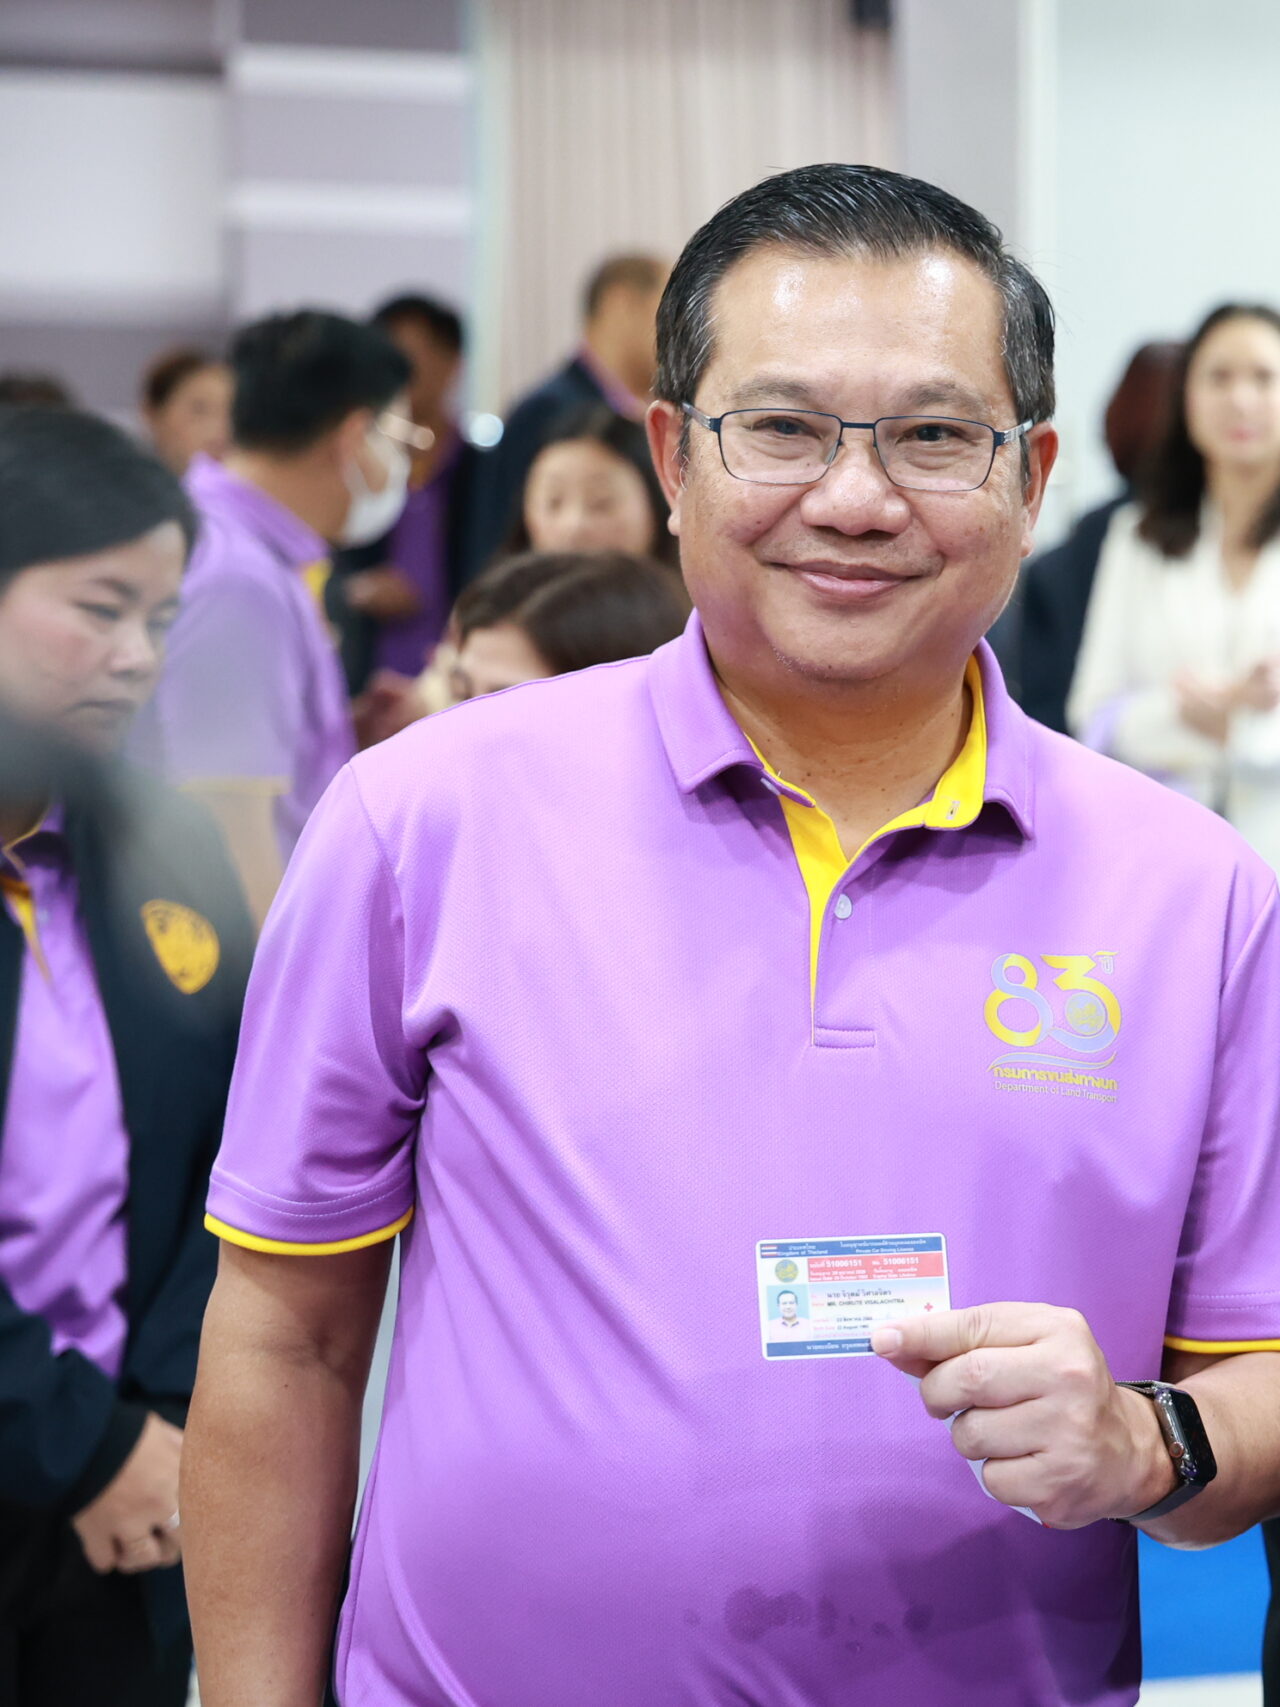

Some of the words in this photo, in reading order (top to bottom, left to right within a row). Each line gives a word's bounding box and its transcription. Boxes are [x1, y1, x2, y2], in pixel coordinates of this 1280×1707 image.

[993, 1067, 1119, 1090] กรมการขนส่งทางบก
[994, 1081, 1048, 1093] Department
[1062, 1087, 1081, 1097] Land
